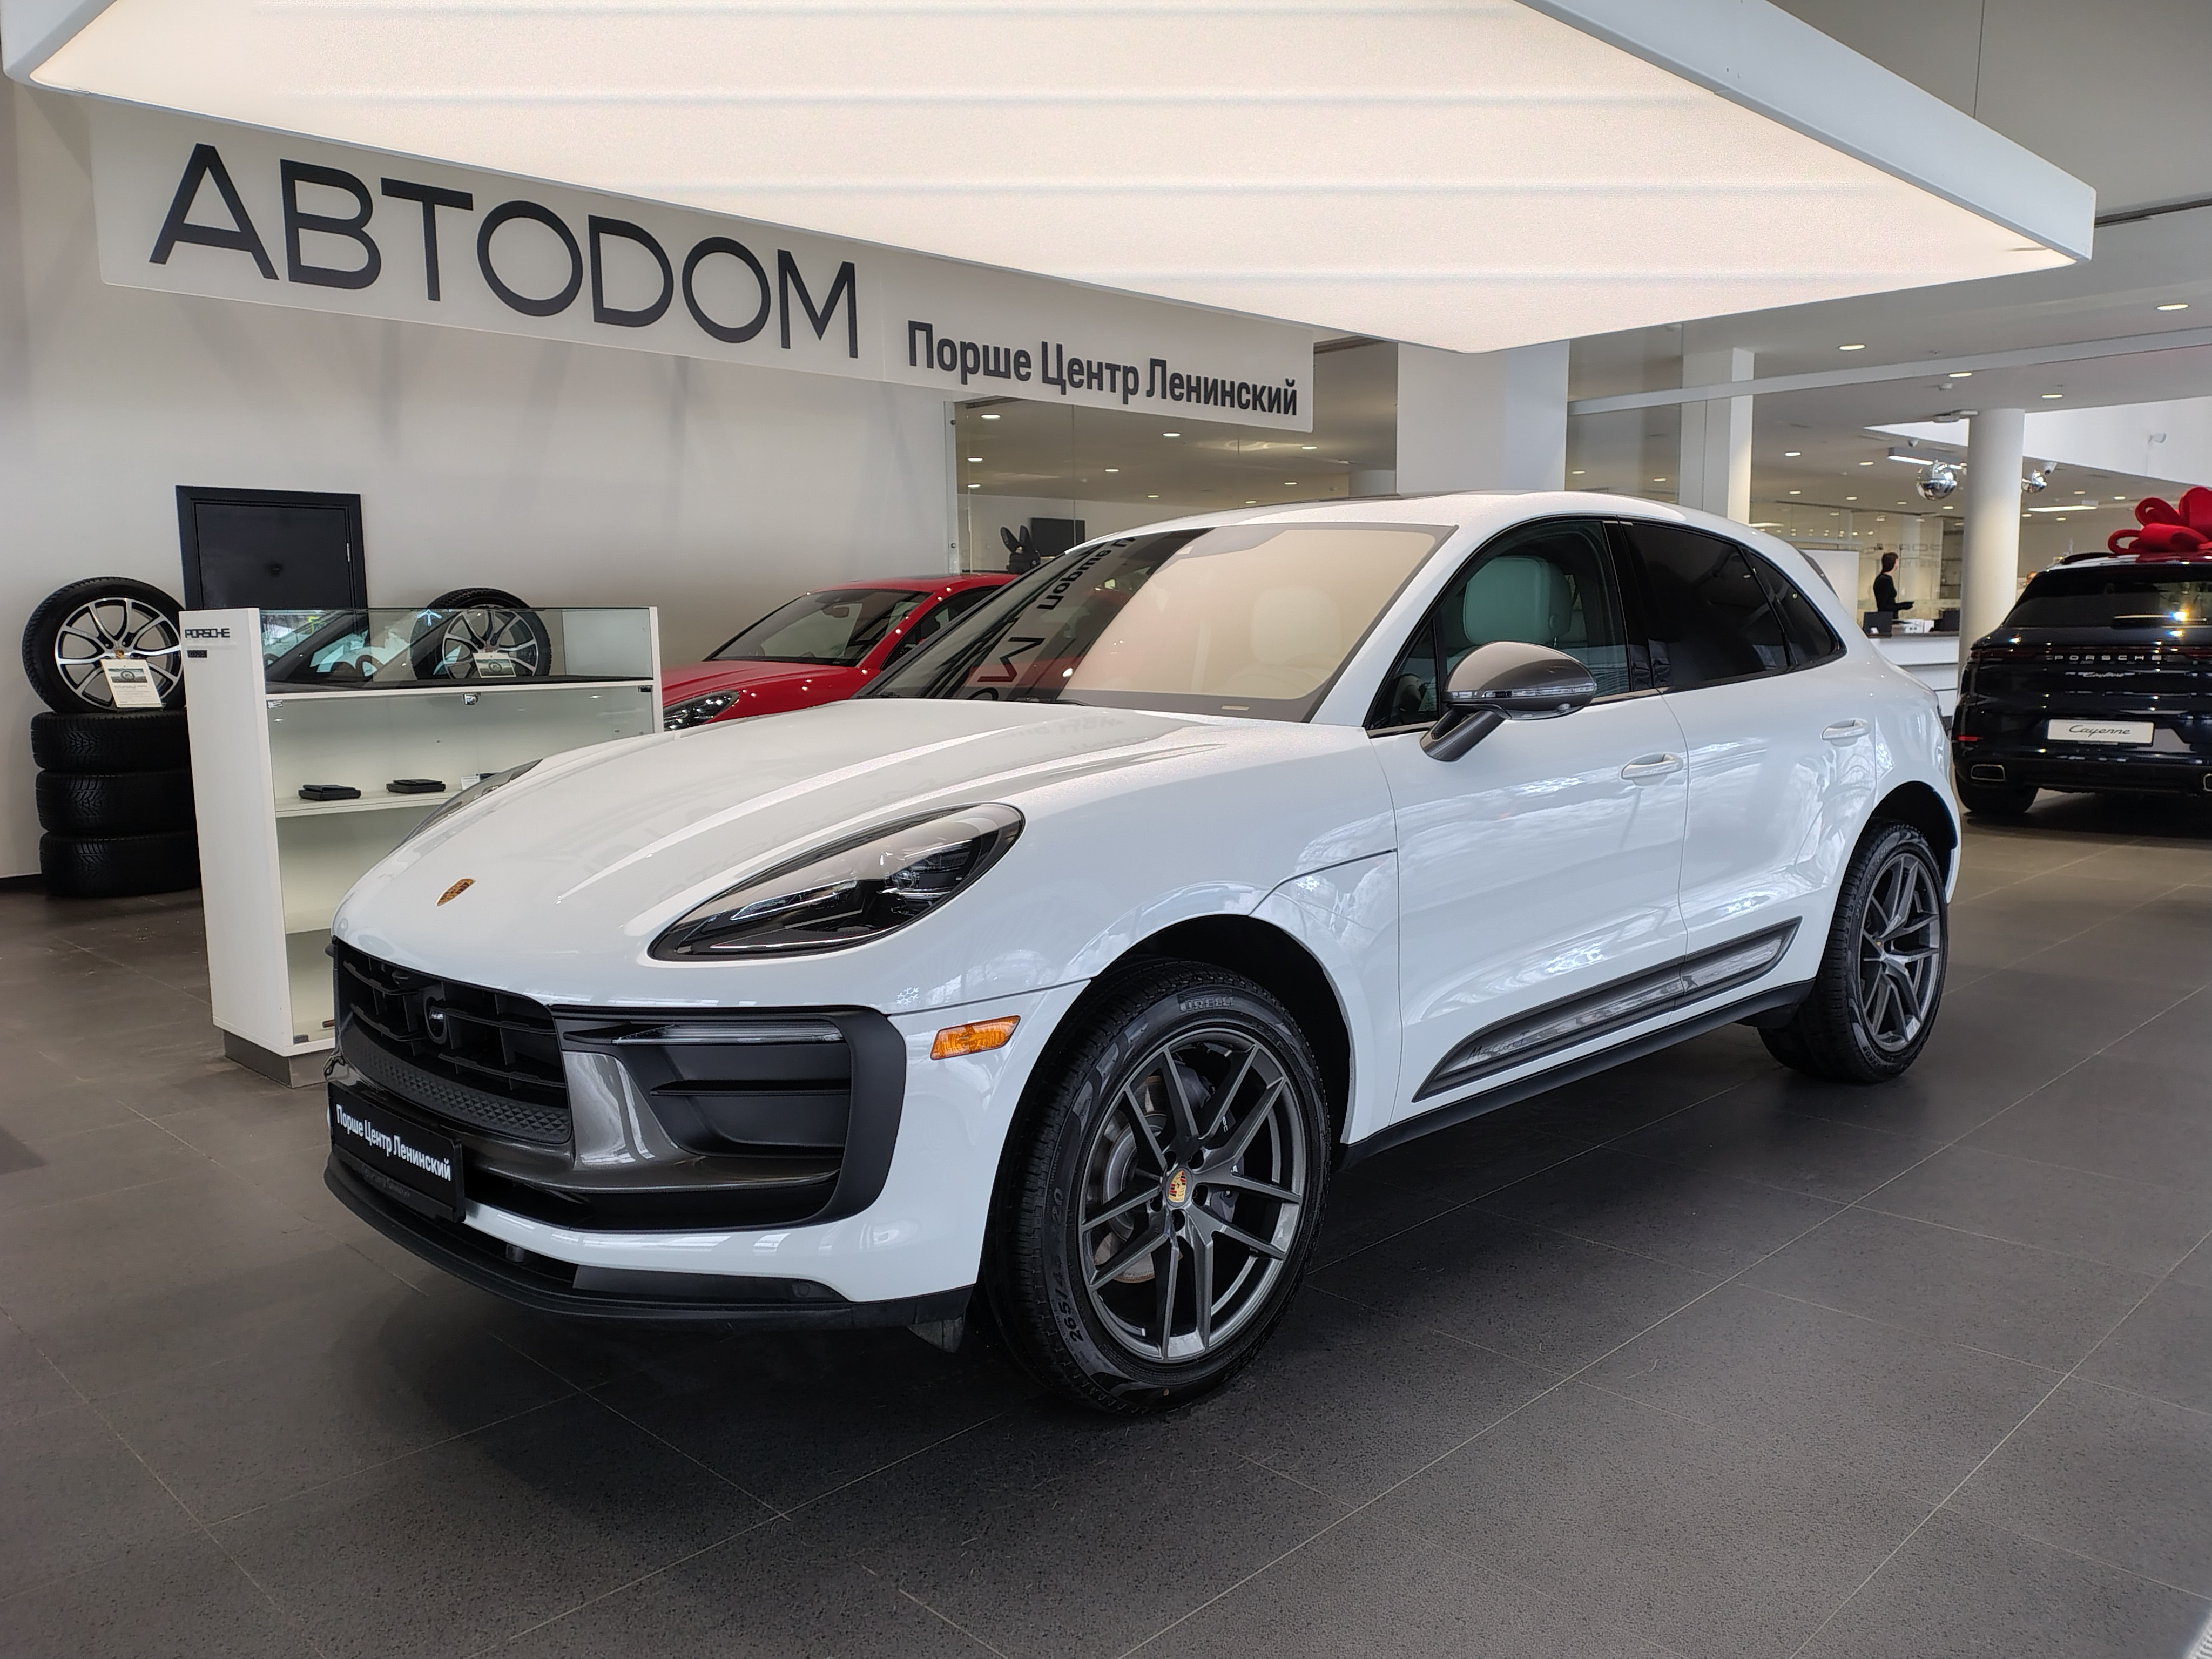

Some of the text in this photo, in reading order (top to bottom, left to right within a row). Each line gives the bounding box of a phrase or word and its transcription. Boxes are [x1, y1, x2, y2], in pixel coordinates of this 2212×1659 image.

[908, 320, 1297, 416] Порше Центр Ленинский
[185, 628, 230, 638] PORSCHE
[2069, 725, 2131, 737] Cayenne
[1179, 996, 1234, 1013] PIRELLI
[336, 1104, 363, 1136] Порше
[365, 1120, 392, 1157] Центр
[394, 1135, 451, 1181] Ленинский
